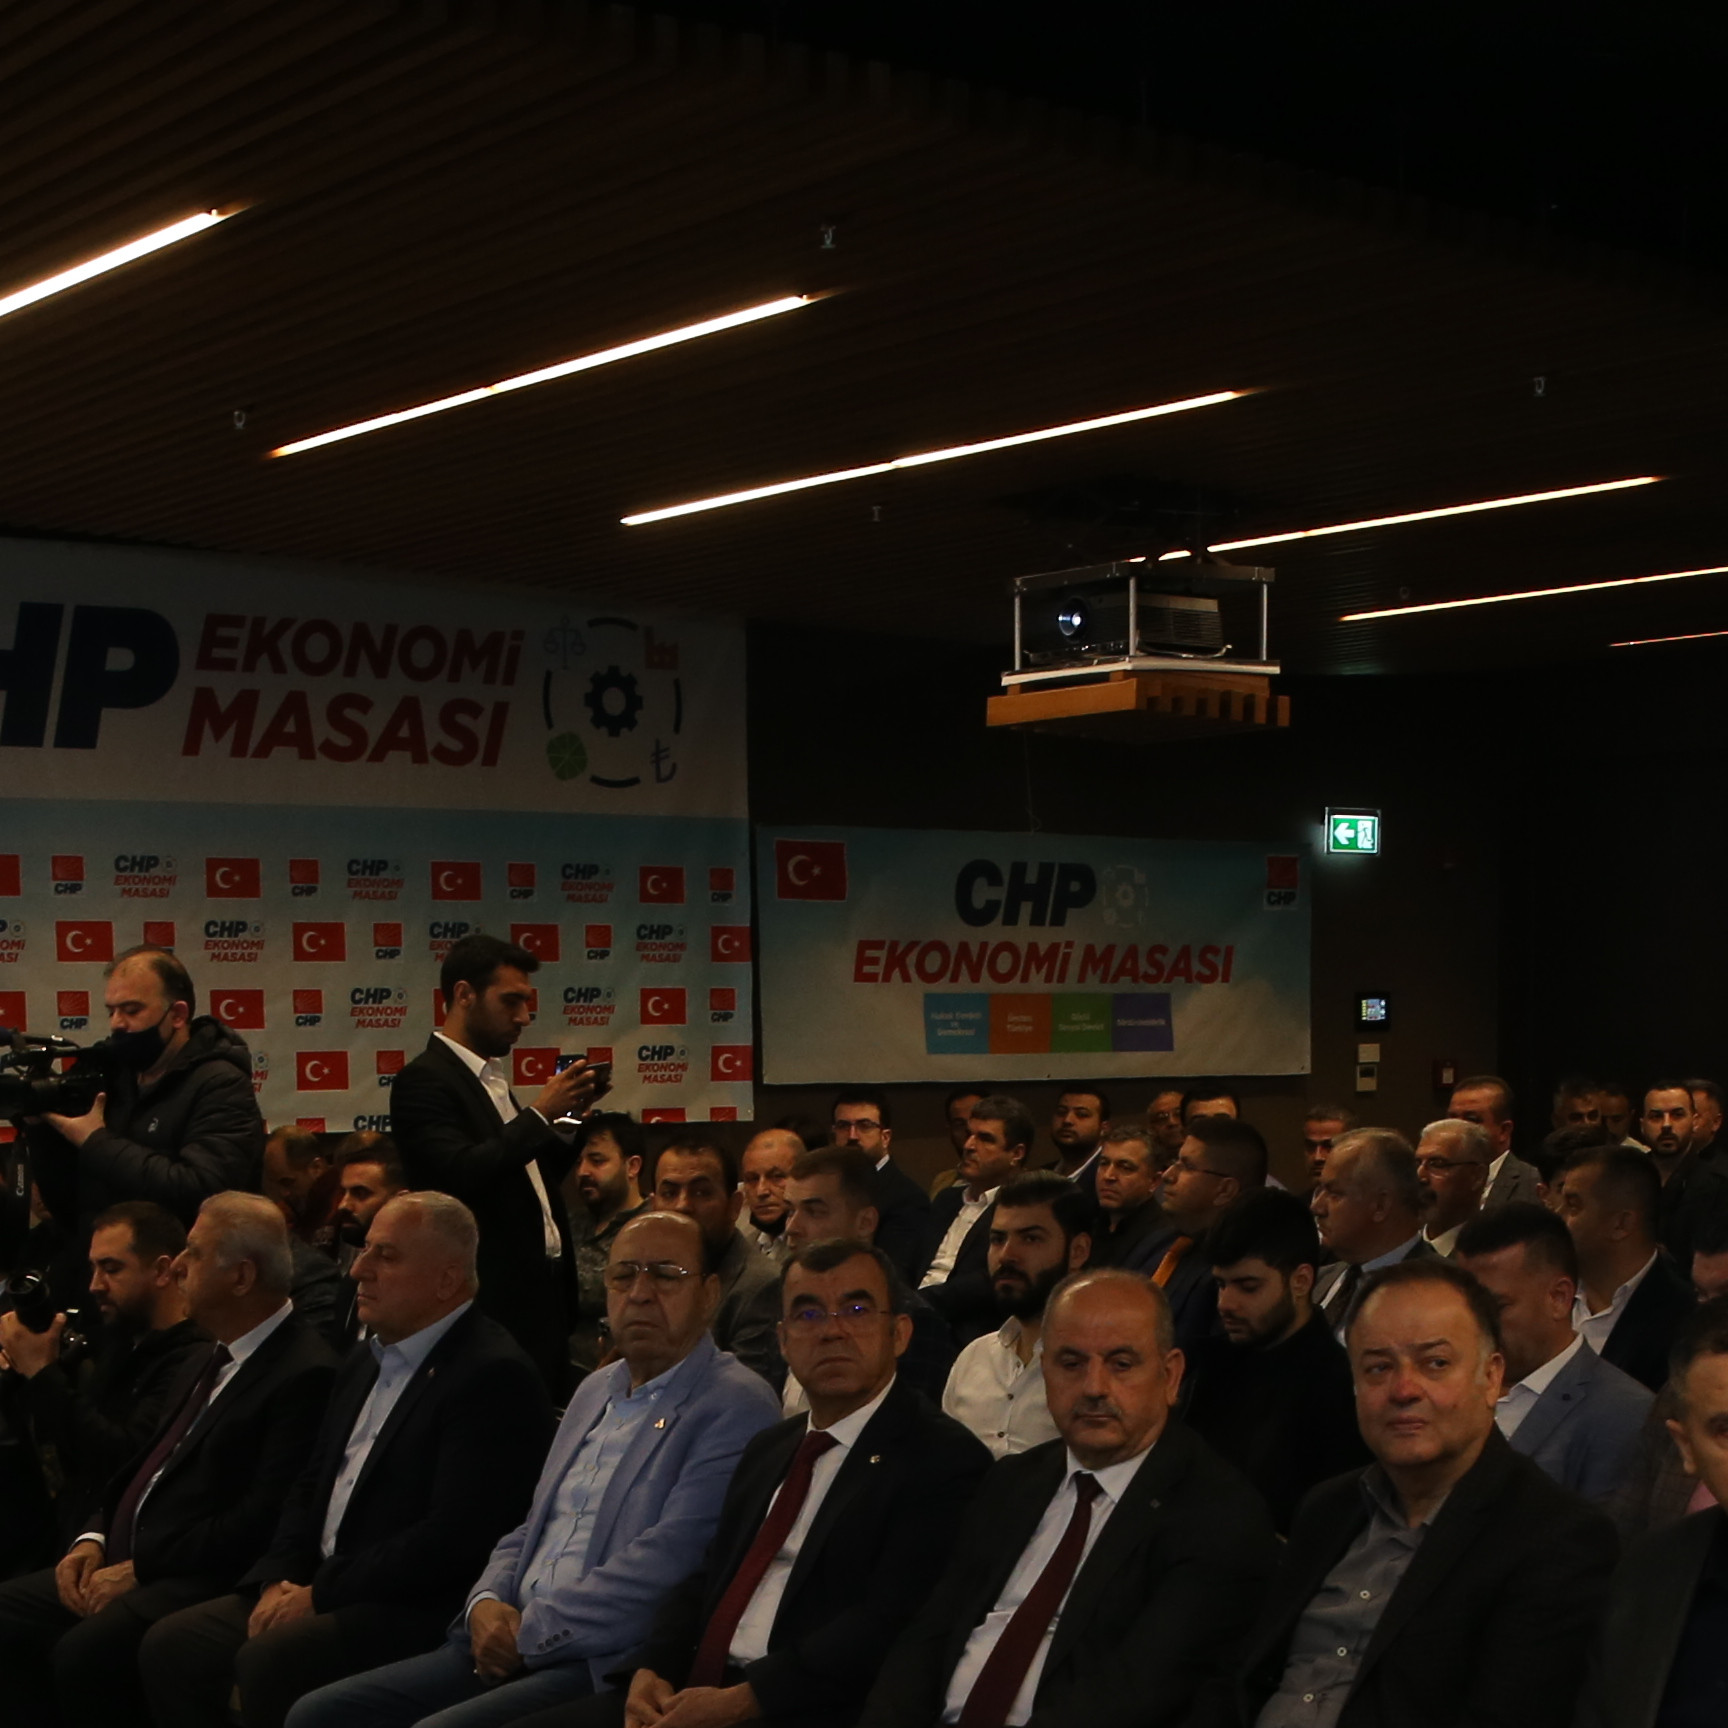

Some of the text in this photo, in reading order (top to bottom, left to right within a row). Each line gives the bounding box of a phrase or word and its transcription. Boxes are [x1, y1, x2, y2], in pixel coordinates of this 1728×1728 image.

[182, 686, 510, 768] MASASI
[114, 855, 159, 873] CHP
[347, 859, 389, 876] CHP
[561, 863, 600, 880] CHP
[54, 882, 83, 895] CHP
[121, 886, 170, 898] MASASI
[291, 885, 318, 898] CHP
[352, 889, 399, 900] MASASI
[510, 888, 535, 899] CHP
[955, 858, 1098, 928] CHP
[566, 893, 609, 903] MASASI
[1265, 889, 1297, 906] CHP
[204, 920, 248, 938] CHP
[429, 921, 470, 939] CHP
[636, 923, 674, 940] CHP
[210, 951, 258, 963] MASASI
[375, 948, 401, 960] CHP
[586, 949, 610, 960] CHP
[640, 952, 681, 963] MASASI
[1077, 942, 1235, 985] MASASI
[350, 987, 392, 1005] CHP
[563, 987, 602, 1004] CHP
[60, 1017, 88, 1030] CHP
[295, 1014, 322, 1027] CHP
[355, 1018, 401, 1029] MASASI
[567, 1015, 610, 1026] MASASI
[637, 1045, 676, 1062] CHP
[642, 1073, 683, 1084] MASASI
